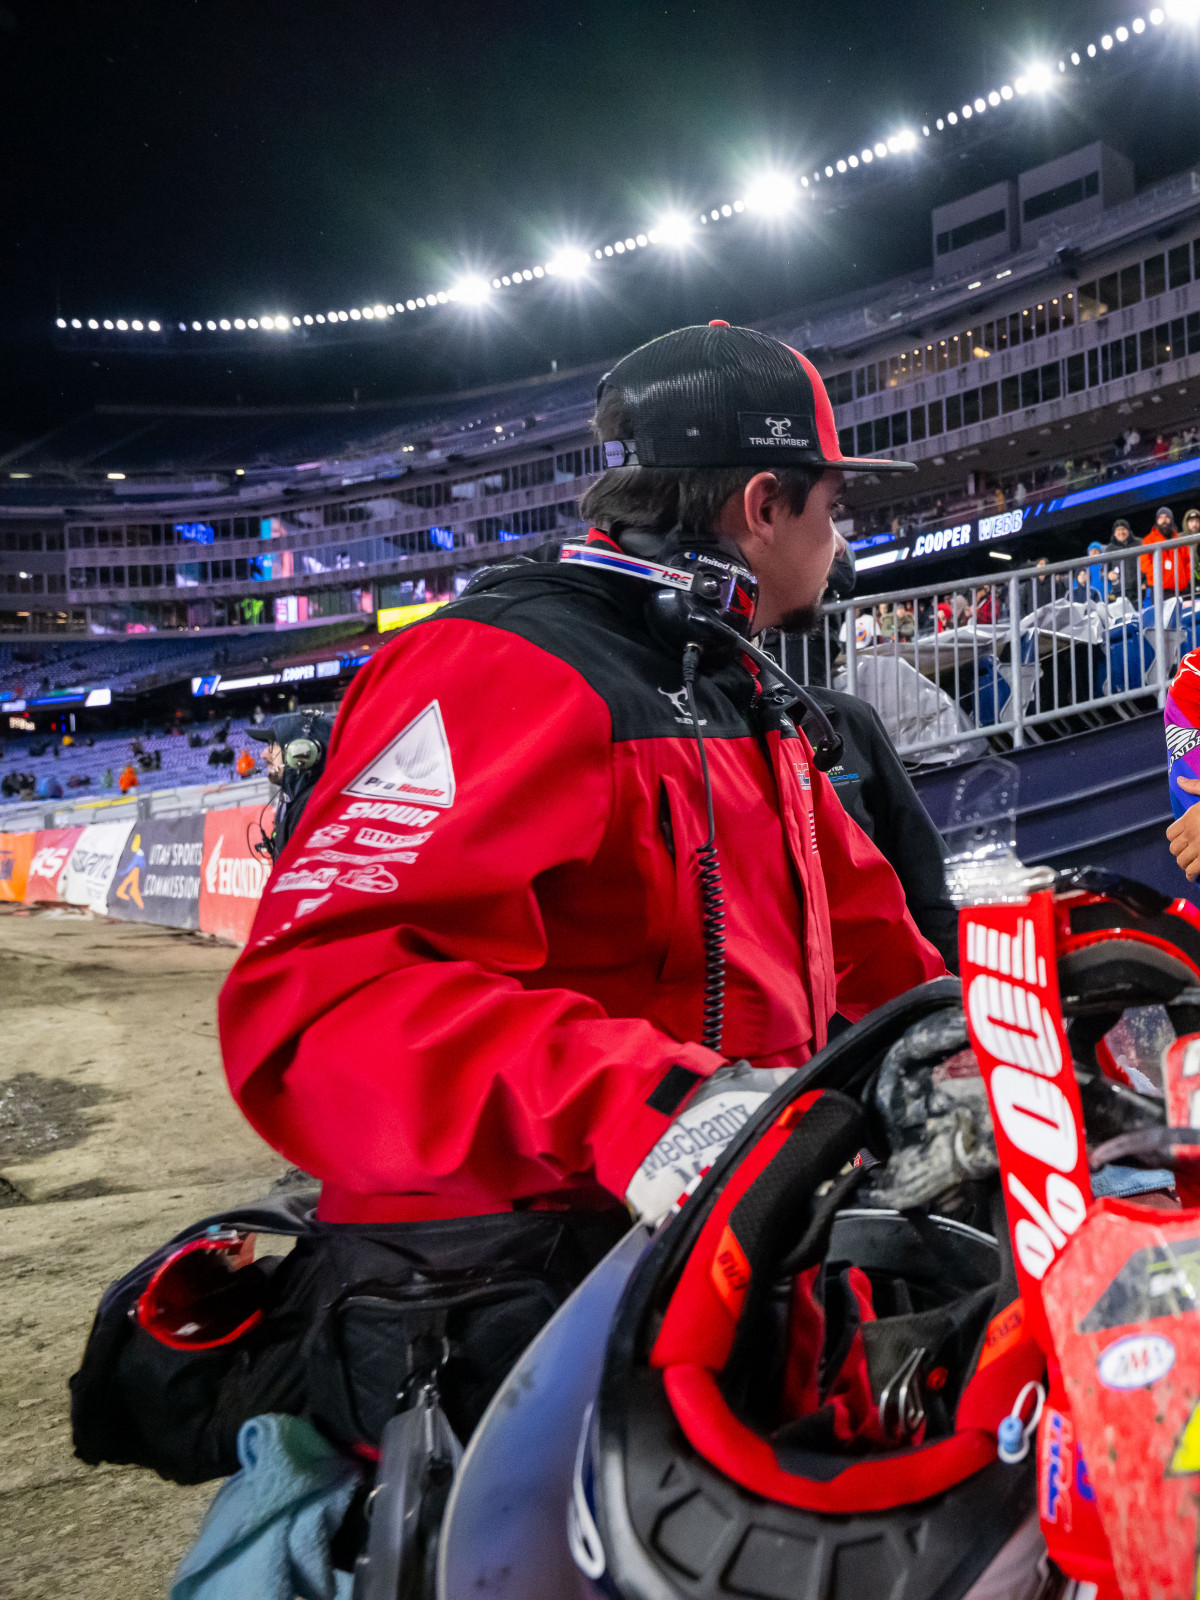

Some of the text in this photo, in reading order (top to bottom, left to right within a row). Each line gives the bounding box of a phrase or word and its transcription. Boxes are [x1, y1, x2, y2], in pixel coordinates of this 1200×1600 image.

[748, 436, 808, 447] TRUETIMBER
[913, 508, 1024, 557] COOPER WEBB
[698, 554, 730, 571] United
[364, 776, 445, 798] Pro Honda
[338, 801, 440, 828] SHOWA
[171, 842, 204, 866] SPORTS
[641, 1103, 752, 1181] Mechanix
